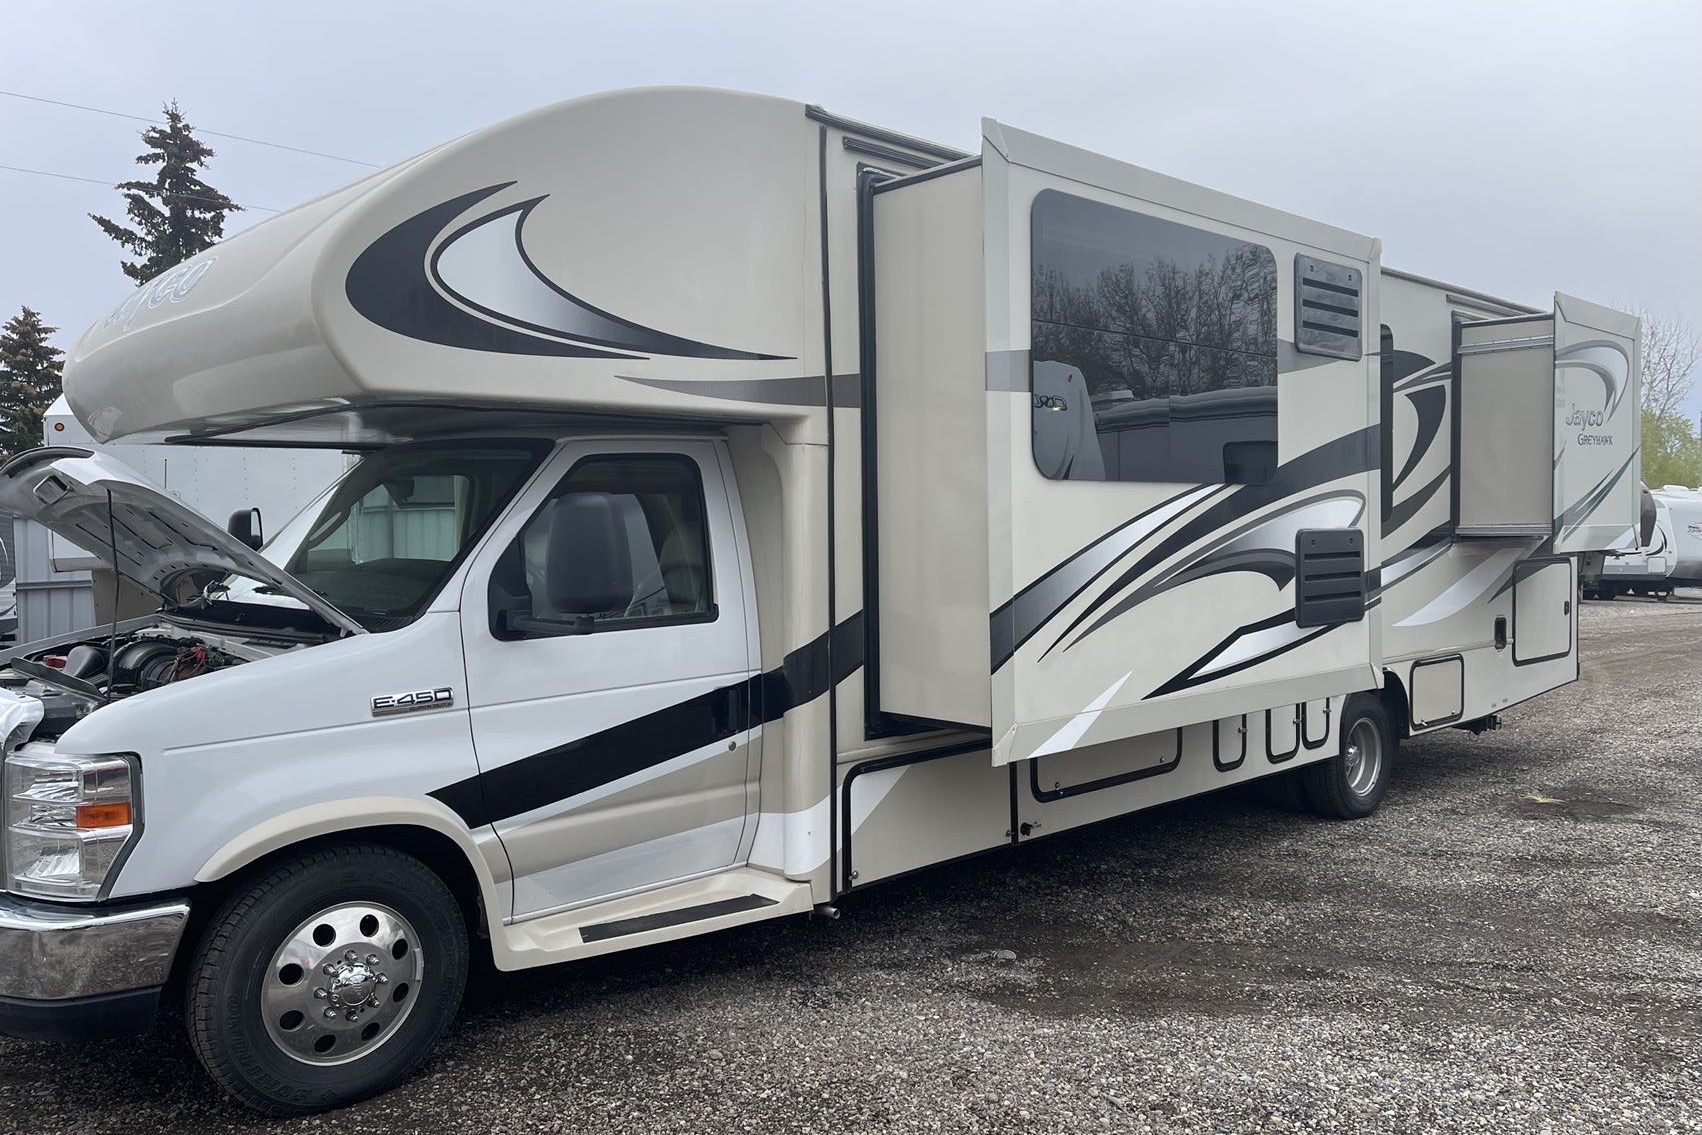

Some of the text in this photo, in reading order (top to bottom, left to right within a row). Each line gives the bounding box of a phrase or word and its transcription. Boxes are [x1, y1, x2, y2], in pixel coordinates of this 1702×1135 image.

[1565, 403, 1604, 431] Jayco
[1577, 433, 1614, 446] GREYHAWK
[373, 689, 452, 709] E-450
